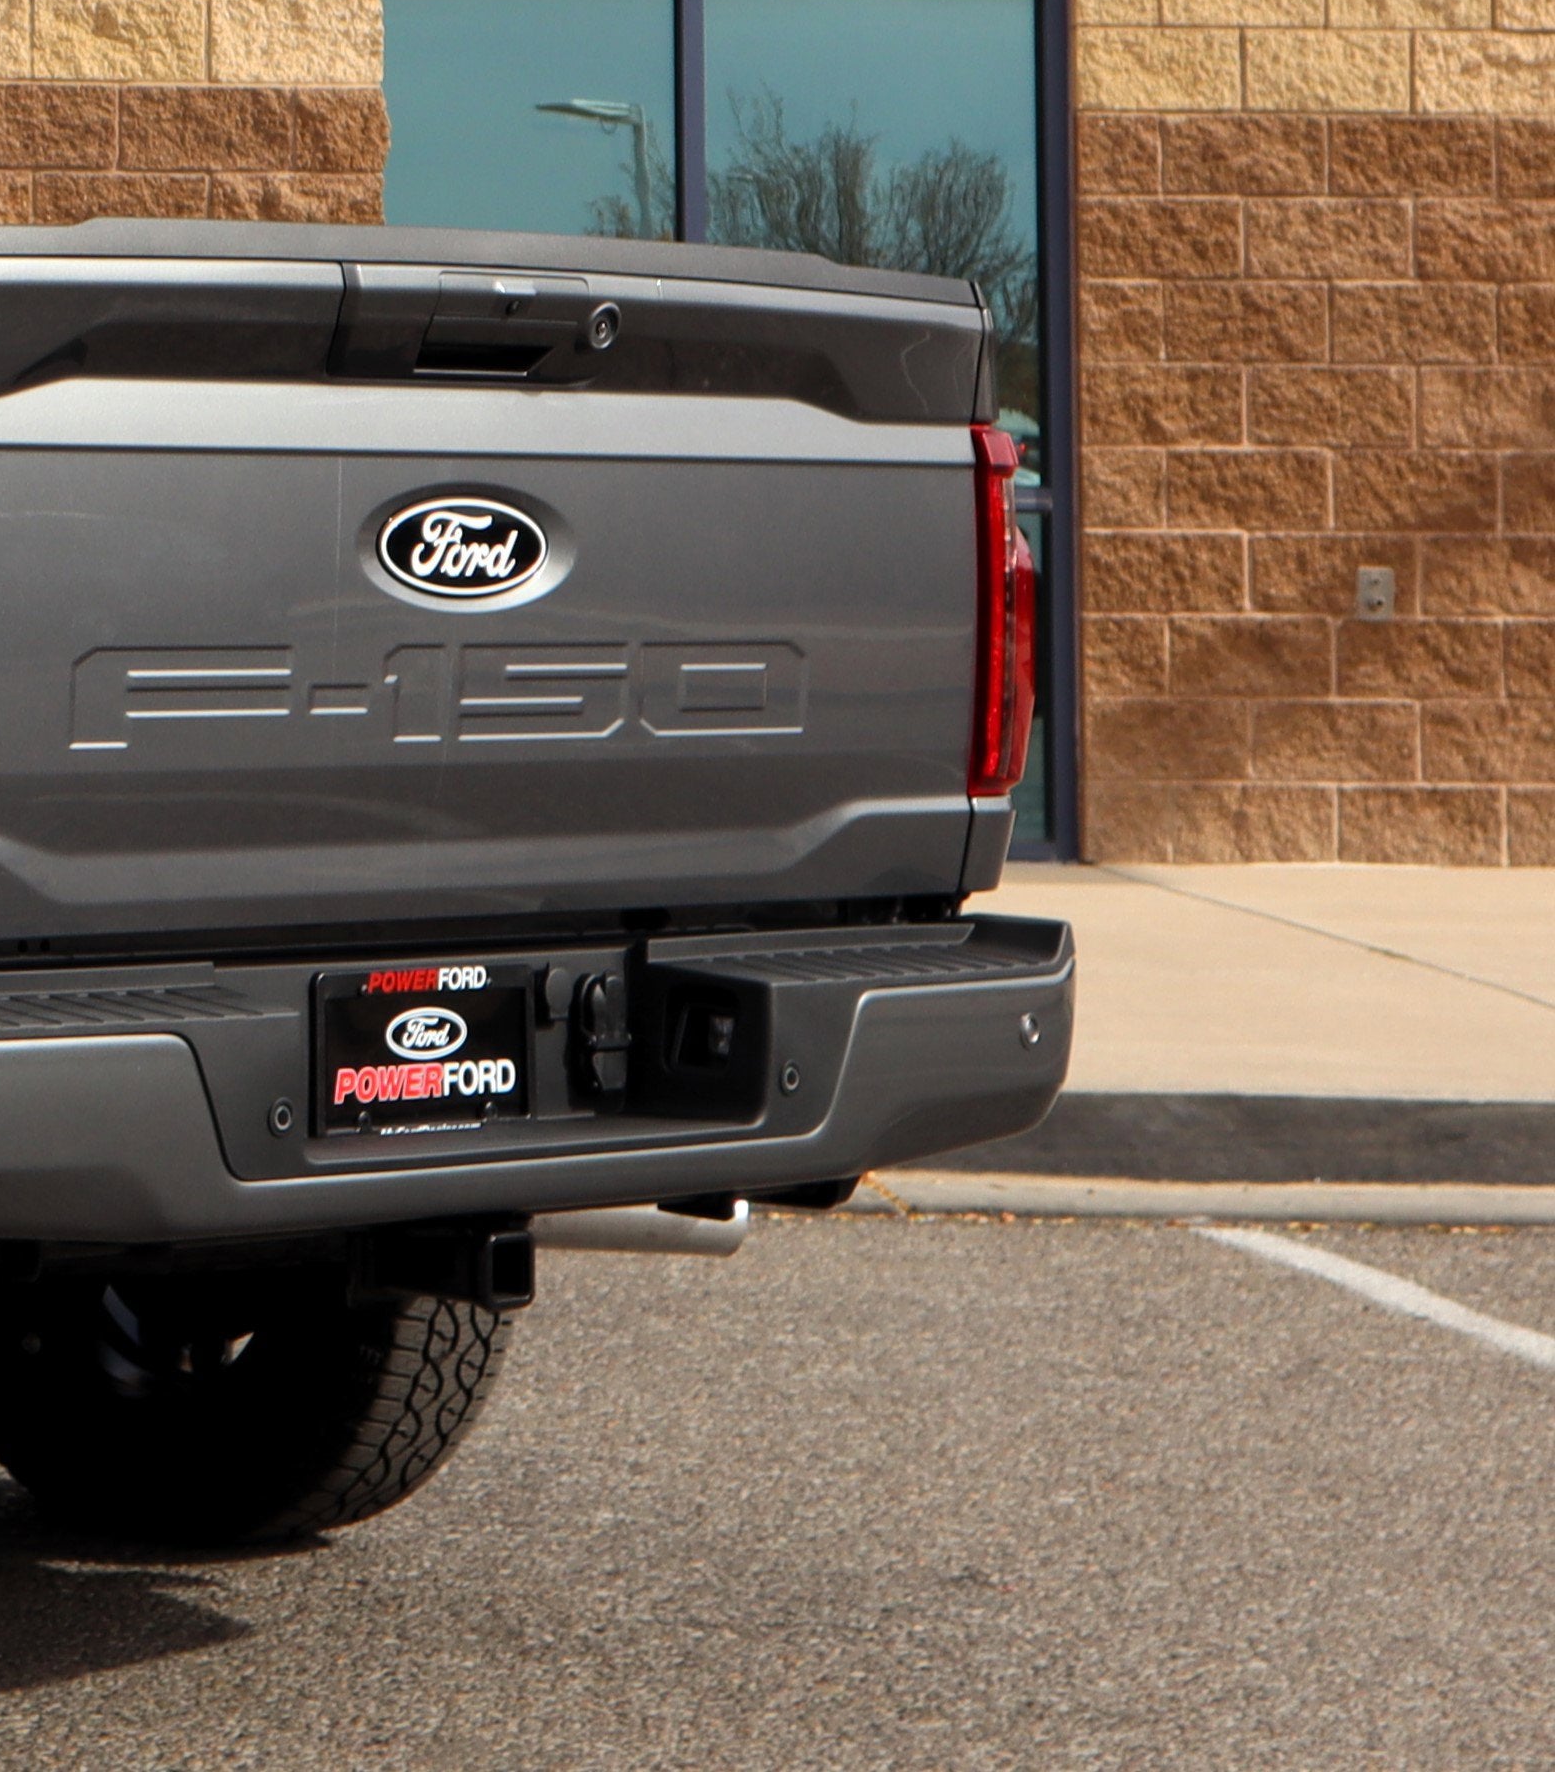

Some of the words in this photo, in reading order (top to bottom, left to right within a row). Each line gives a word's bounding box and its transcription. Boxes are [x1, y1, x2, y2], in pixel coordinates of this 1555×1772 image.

[409, 510, 520, 580] Ford
[67, 640, 808, 751] F-150
[401, 1015, 452, 1049] Ford
